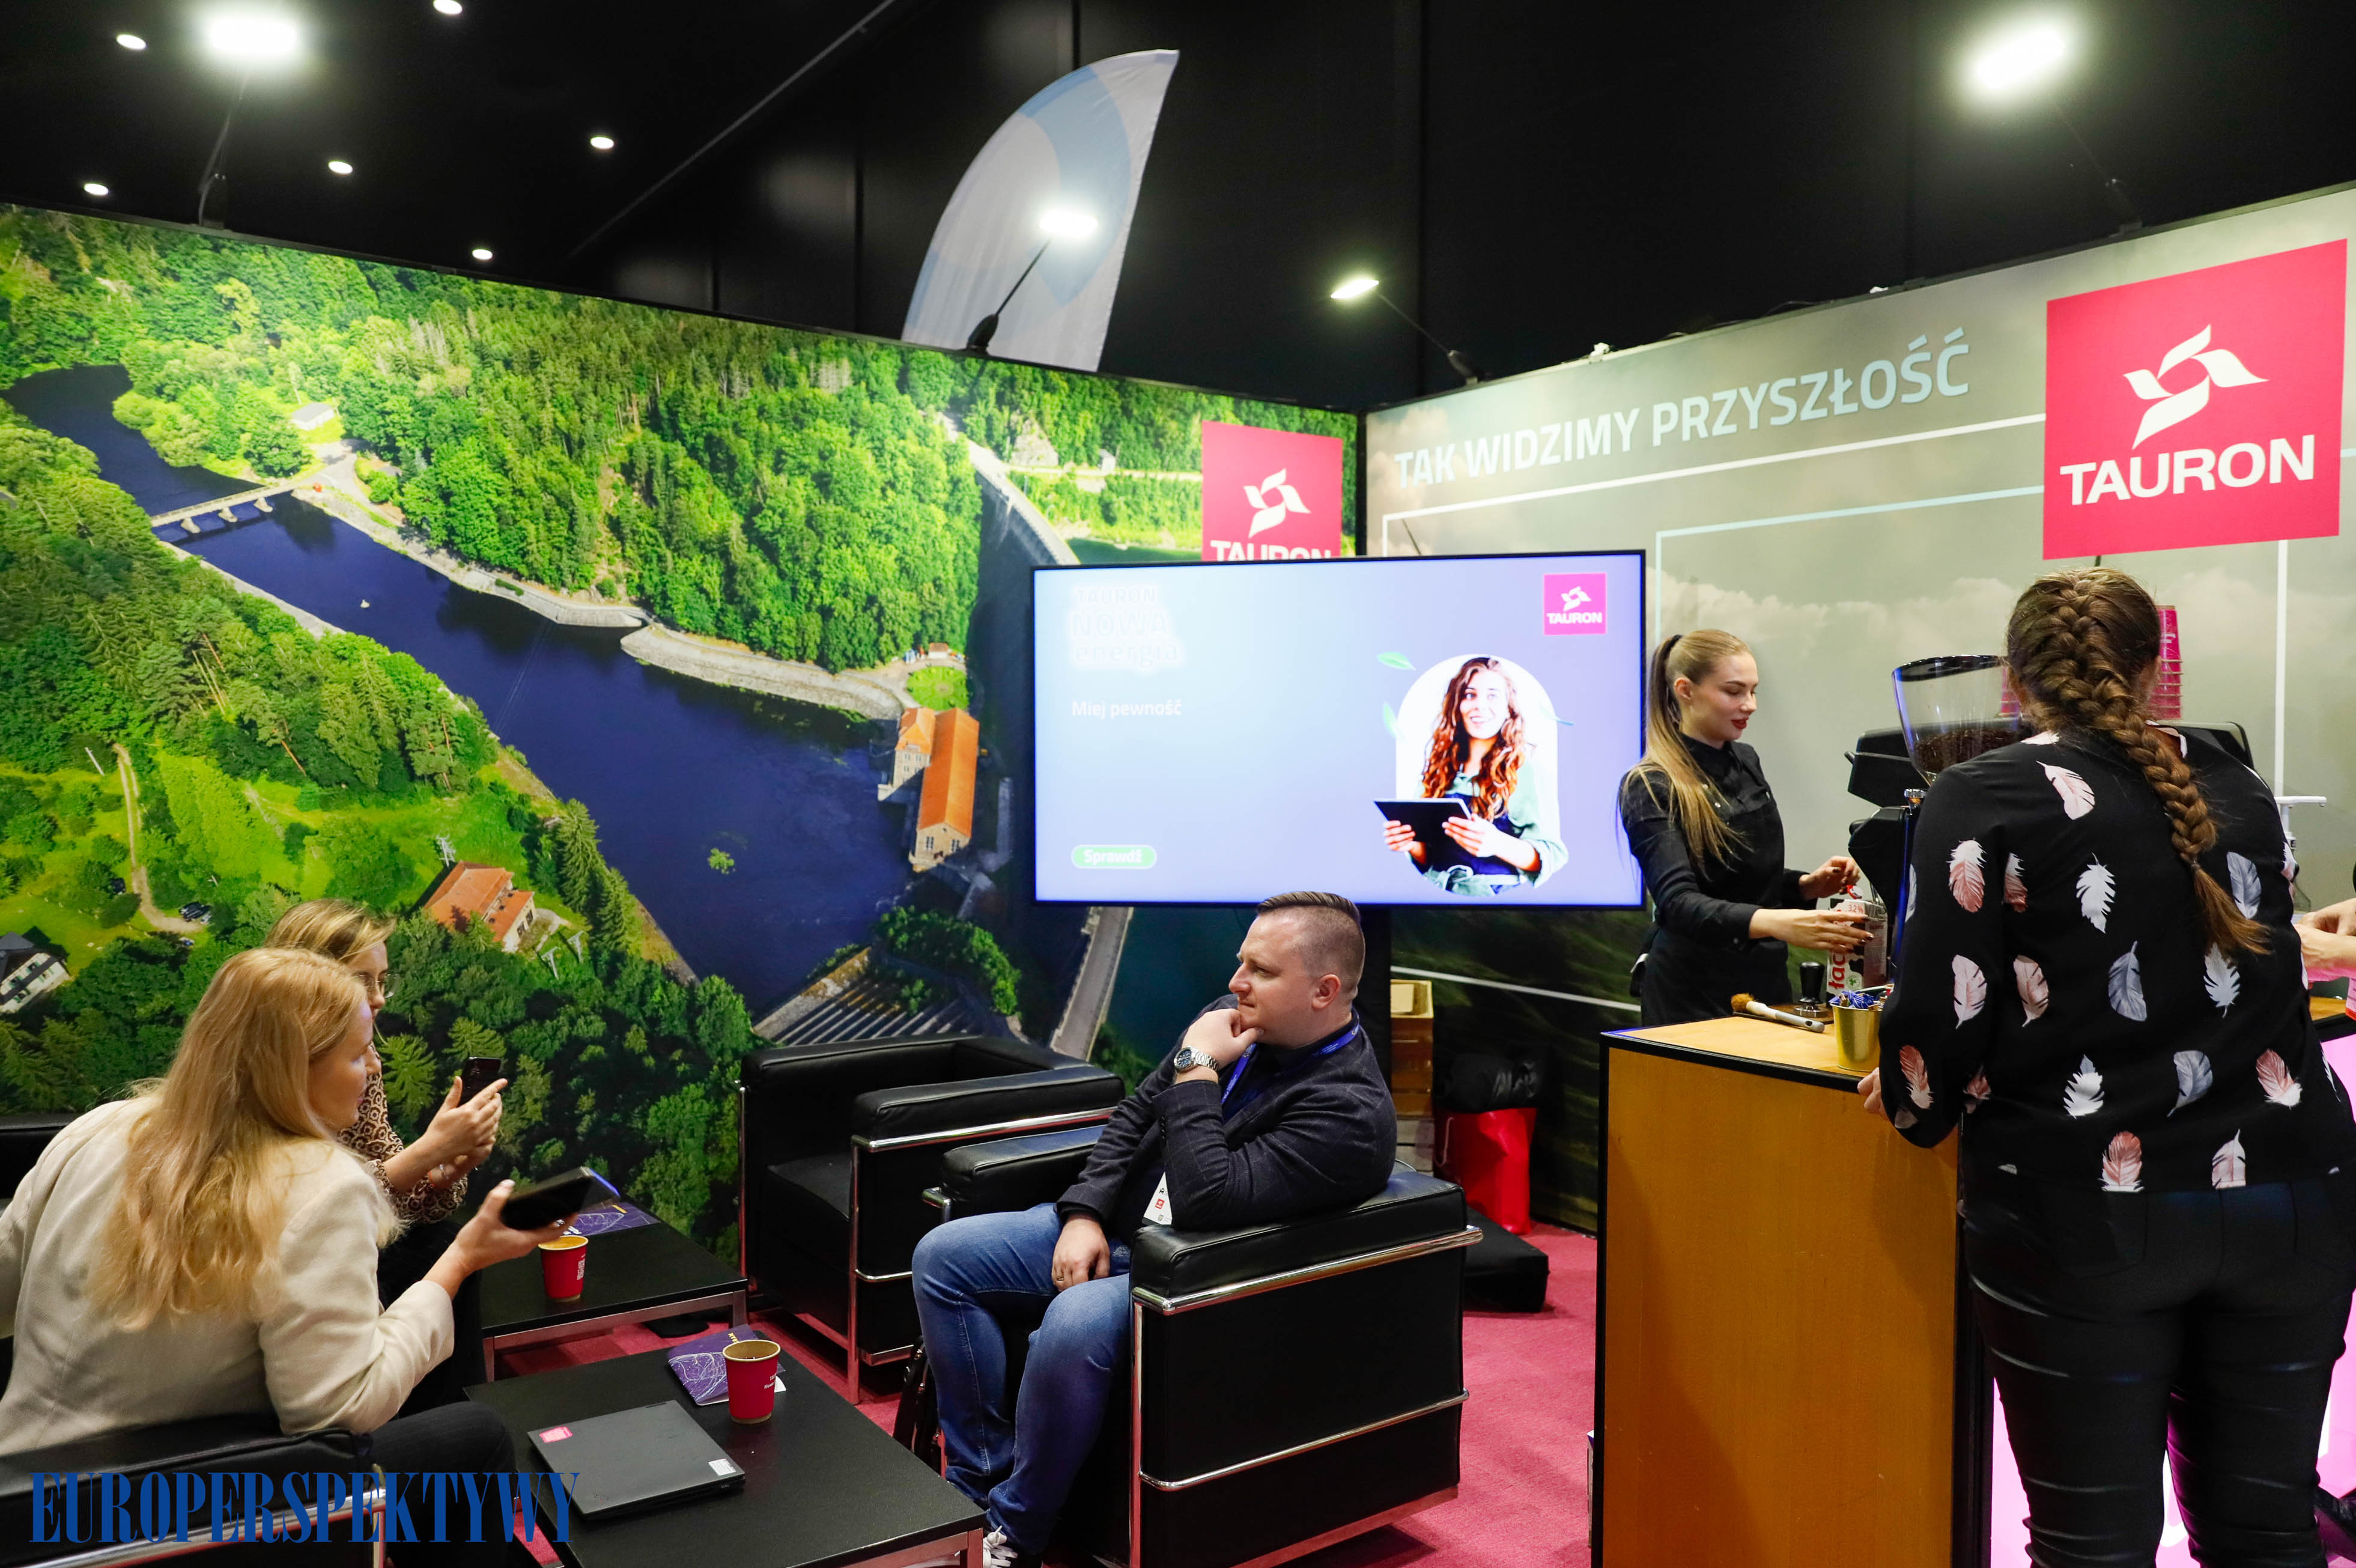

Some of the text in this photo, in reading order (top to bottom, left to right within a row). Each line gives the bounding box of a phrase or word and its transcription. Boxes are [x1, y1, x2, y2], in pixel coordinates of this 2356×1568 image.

[1394, 326, 1969, 488] TAK WIDZIMY PRZYSZŁOŚĆ
[2060, 434, 2315, 506] TAURON
[1077, 588, 1156, 604] TAURON
[1072, 613, 1169, 637] NOWA
[1546, 612, 1603, 624] TAURON
[1075, 642, 1179, 669] energia
[1072, 697, 1183, 720] Miej pewność
[1084, 849, 1143, 865] Sprawdź
